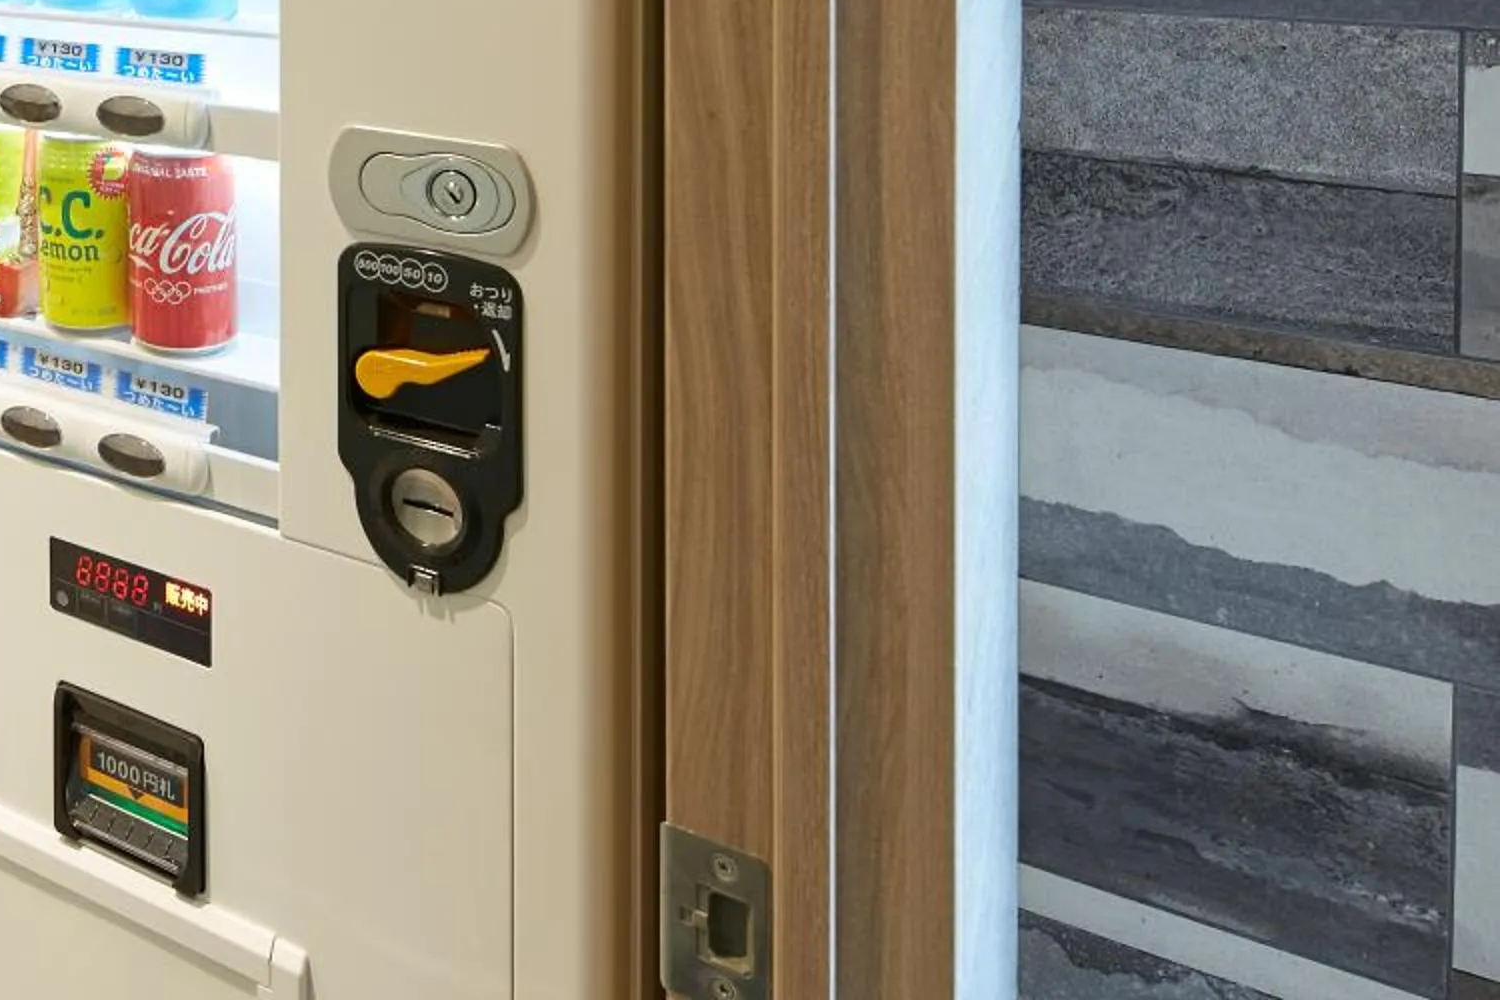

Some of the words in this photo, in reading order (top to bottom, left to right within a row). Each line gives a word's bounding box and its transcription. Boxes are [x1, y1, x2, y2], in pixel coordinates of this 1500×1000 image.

[38, 41, 83, 57] ¥130
[135, 51, 185, 67] ¥130
[41, 239, 99, 261] emon
[130, 212, 235, 274] ca-Cola
[403, 267, 421, 279] 50
[428, 272, 443, 284] 10
[470, 282, 513, 303] おつり
[38, 352, 83, 374] ¥130
[137, 377, 185, 399] ¥130
[165, 582, 209, 616] 販売中
[97, 751, 175, 800] 1000円札
